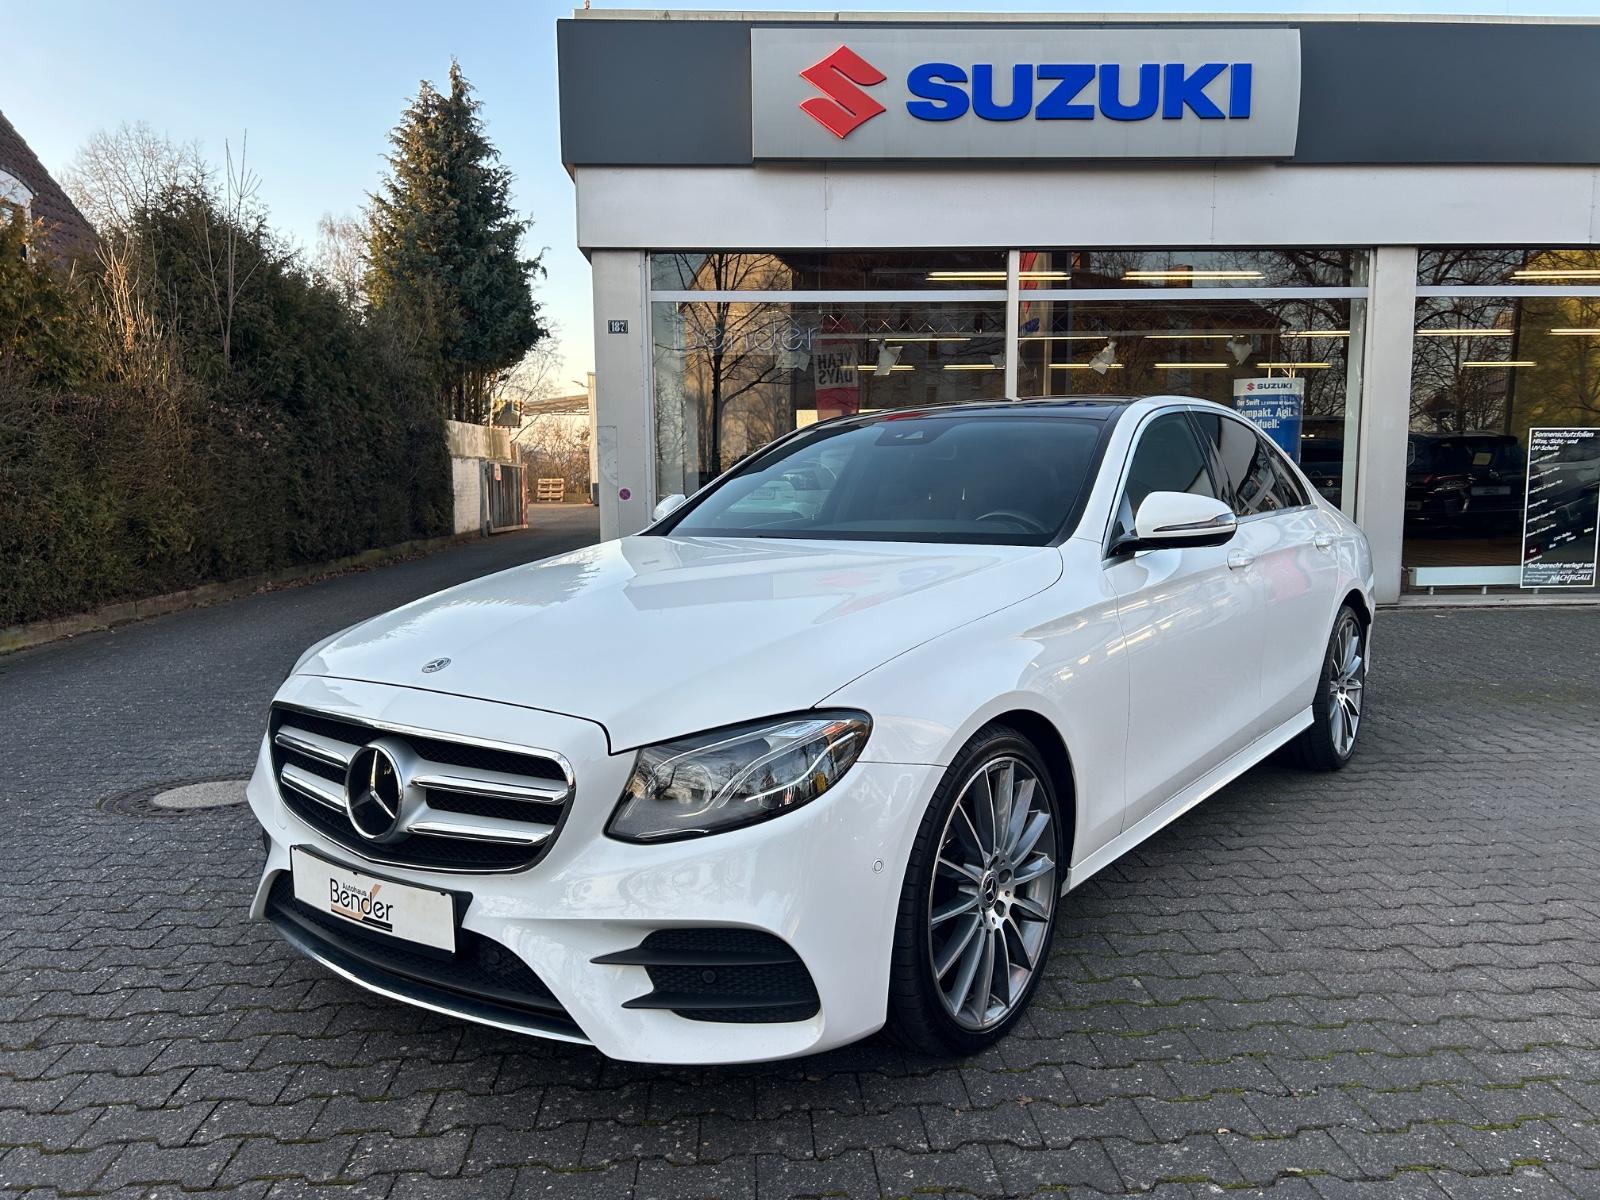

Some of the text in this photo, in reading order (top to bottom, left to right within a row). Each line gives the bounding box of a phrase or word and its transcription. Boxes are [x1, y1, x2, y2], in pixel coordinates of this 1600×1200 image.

[906, 63, 1252, 122] SUZUKI
[611, 321, 625, 332] 187
[1276, 408, 1293, 418] Agil.
[343, 882, 367, 896] Autohaus
[330, 878, 393, 921] Bender
